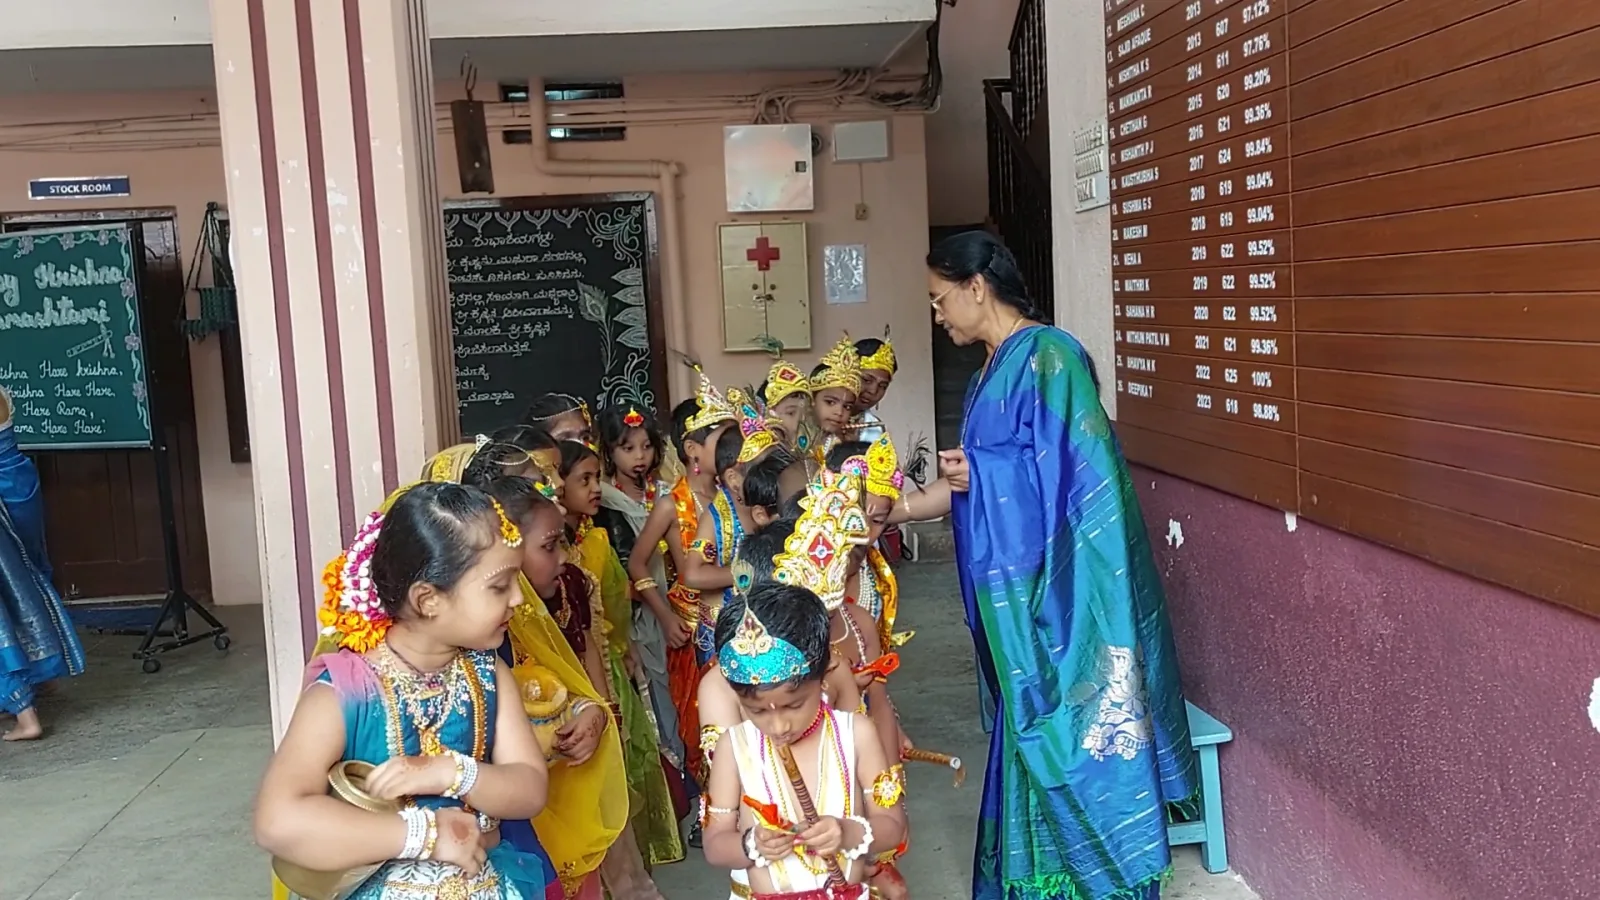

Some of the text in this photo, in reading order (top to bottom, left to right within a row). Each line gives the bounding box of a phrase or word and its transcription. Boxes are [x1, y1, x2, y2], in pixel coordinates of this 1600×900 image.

[1141, 4, 1145, 17] C
[1186, 2, 1200, 20] 2013
[1145, 57, 1150, 71] S
[1187, 32, 1201, 51] 2013
[1216, 18, 1228, 37] 607
[1243, 0, 1269, 23] 97.12%
[1188, 63, 1202, 81] 2014
[1217, 51, 1229, 68] 611
[1243, 33, 1270, 57] 97.76%
[1143, 115, 1147, 128] G
[1188, 94, 1202, 112] 2015
[1217, 83, 1229, 100] 620
[1244, 68, 1270, 90] 99.20%
[1146, 141, 1149, 155] P
[1189, 124, 1203, 141] 2016
[1218, 116, 1230, 132] 621
[1245, 103, 1271, 124] 99.36%
[1154, 166, 1159, 180] S
[1190, 155, 1203, 171] 2017
[1218, 148, 1231, 164] 624
[1245, 137, 1272, 157] 99.84%
[49, 183, 112, 194] STOCK ROOM
[1143, 197, 1147, 211] G
[1147, 196, 1152, 210] S
[1191, 186, 1205, 201] 2018
[1219, 180, 1232, 195] 619
[1246, 171, 1273, 190] 99.04%
[1123, 225, 1142, 240] RAKESH
[1192, 216, 1205, 230] 2018
[1220, 212, 1232, 227] 619
[1247, 205, 1274, 223] 99.04%
[1124, 252, 1137, 266] NEHA
[1137, 252, 1142, 264] A
[1192, 246, 1206, 260] 2019
[1221, 243, 1233, 258] 622
[1248, 239, 1274, 256] 99.52%
[34, 257, 125, 290] Krishna
[1145, 278, 1150, 291] K
[1193, 276, 1207, 290] 2019
[1222, 275, 1235, 289] 622
[1249, 271, 1276, 289] 99.52%
[1150, 305, 1155, 319] R
[1194, 306, 1208, 320] 2020
[1223, 306, 1236, 320] 622
[1250, 306, 1277, 322] 99.52%
[1160, 332, 1164, 346] V
[1195, 335, 1209, 349] 2021
[1224, 337, 1236, 351] 621
[1251, 339, 1278, 355] 99.36%
[0, 362, 29, 379] ishna
[39, 359, 69, 379] Hare
[1151, 359, 1156, 372] K
[1196, 365, 1210, 379] 2022
[1225, 368, 1237, 383] 625
[1252, 371, 1272, 388] 100%
[54, 382, 82, 397] Hare
[1128, 382, 1148, 398] DEEPIKA
[1149, 385, 1153, 398] T
[1197, 394, 1211, 409] 2023
[1226, 398, 1238, 414] 618
[1253, 403, 1280, 422] 98.88%
[22, 400, 51, 416] Hare
[13, 424, 36, 434] ama
[41, 418, 68, 434] Hare
